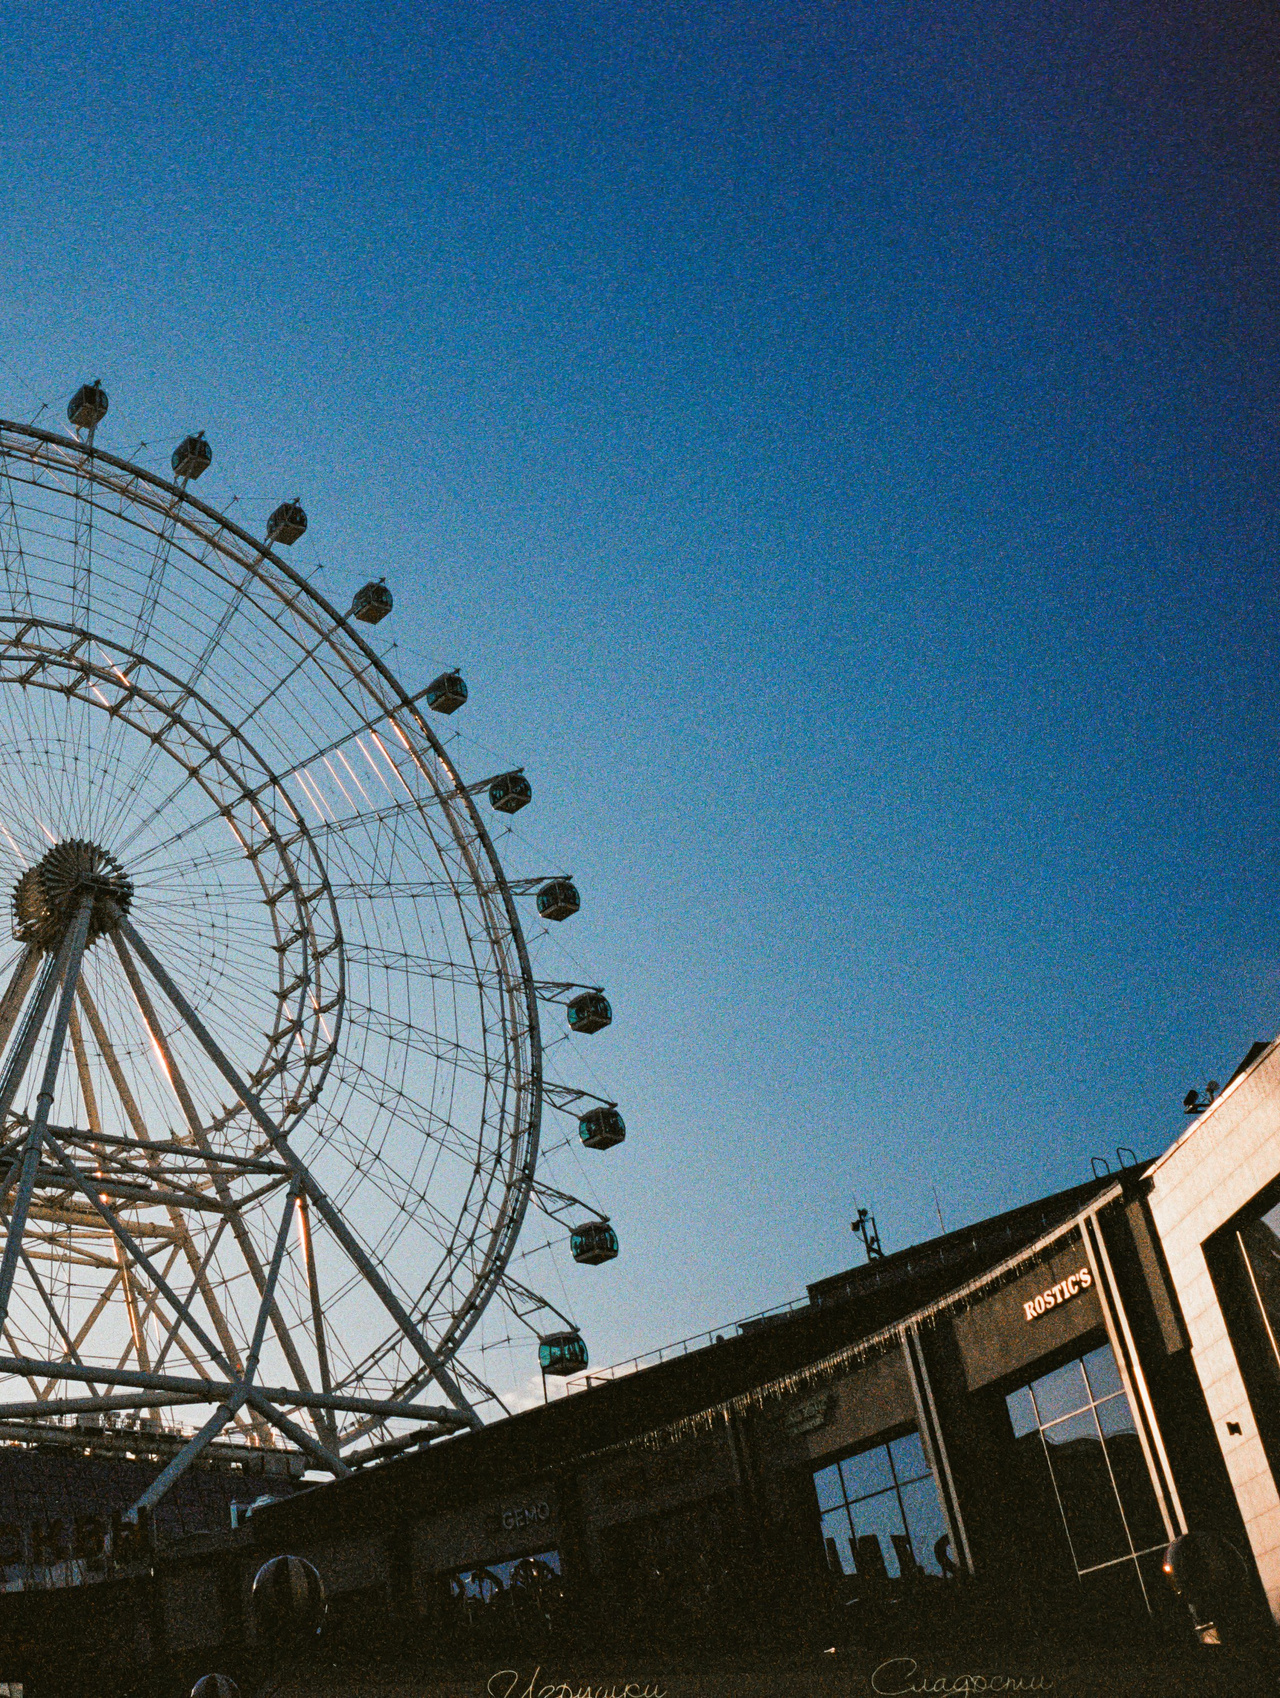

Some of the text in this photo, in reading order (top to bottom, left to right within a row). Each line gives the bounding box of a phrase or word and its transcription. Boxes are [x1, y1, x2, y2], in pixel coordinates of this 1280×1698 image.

[1023, 1268, 1092, 1321] ROSTIC'S
[502, 1501, 550, 1530] GEMO
[871, 1657, 1054, 1698] Сладости
